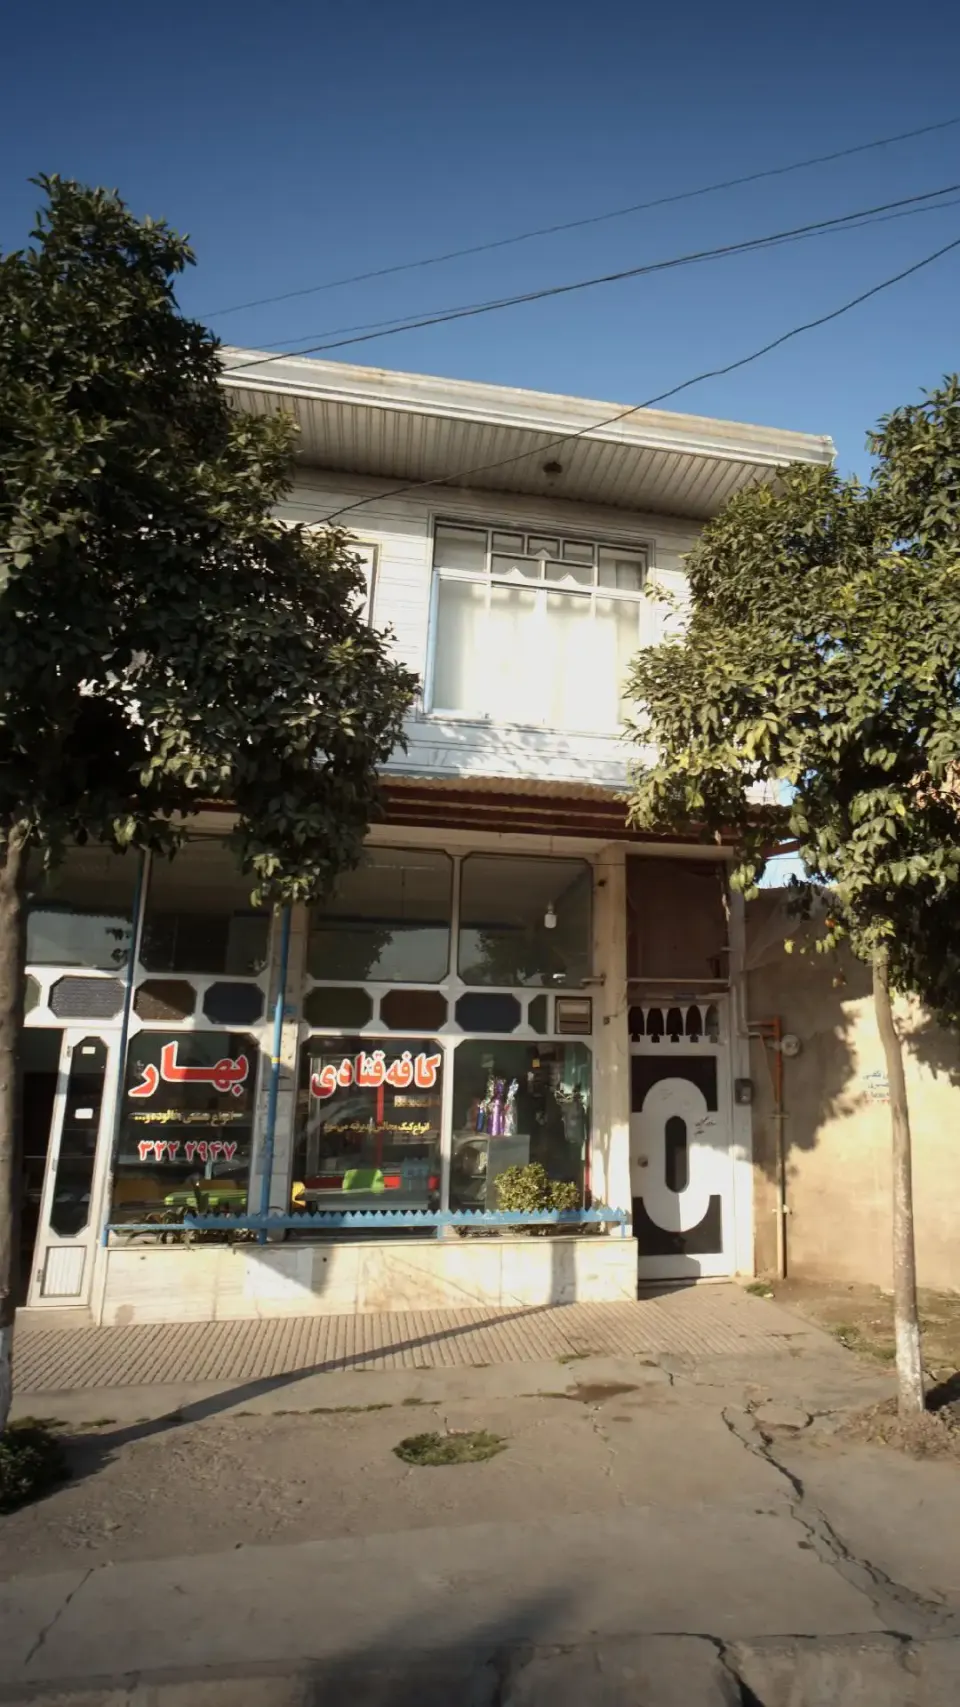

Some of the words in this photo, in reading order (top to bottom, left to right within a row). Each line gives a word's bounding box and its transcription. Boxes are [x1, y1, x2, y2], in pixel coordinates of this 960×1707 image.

[128, 1040, 249, 1097] بهار
[311, 1050, 386, 1099] قنادی
[386, 1050, 441, 1089] کافه
[210, 1111, 234, 1126] انواع
[412, 1121, 431, 1136] انواع
